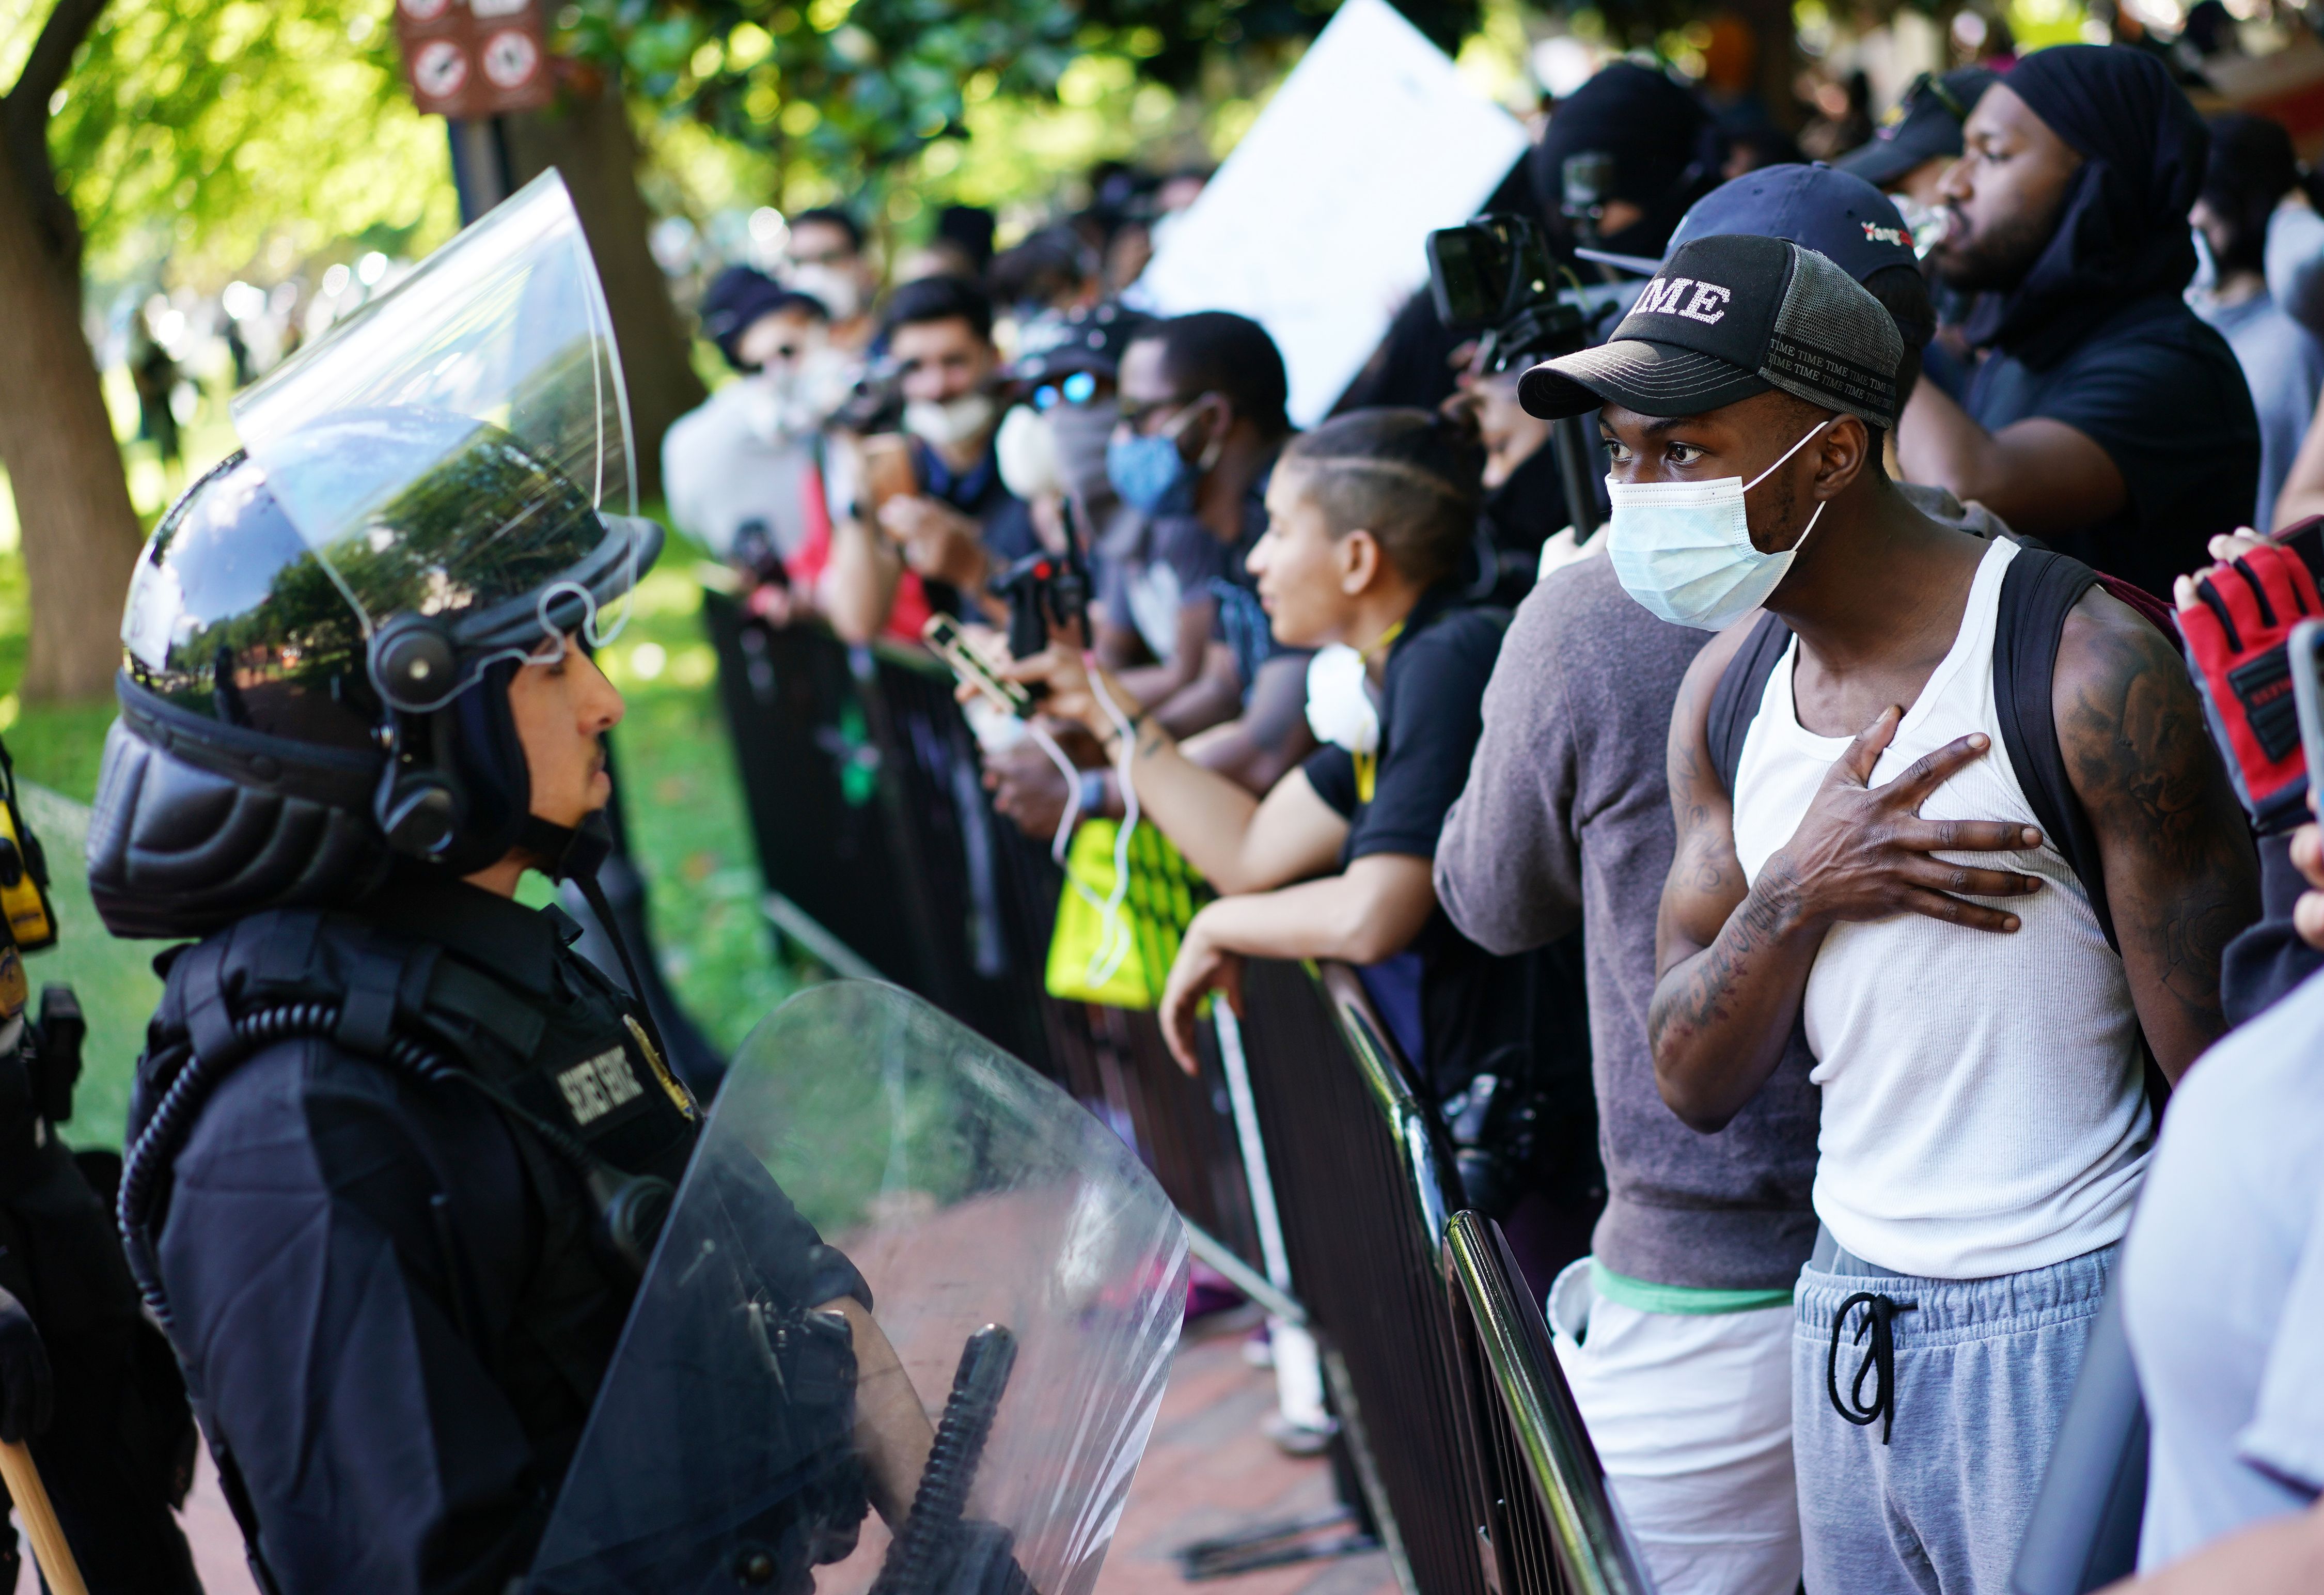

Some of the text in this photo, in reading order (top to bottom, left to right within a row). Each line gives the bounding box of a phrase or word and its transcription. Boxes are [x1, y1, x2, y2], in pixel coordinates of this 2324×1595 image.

[1768, 353, 1793, 371] TIME
[1794, 363, 1820, 381] TIME
[1822, 374, 1845, 391] TIME
[1845, 383, 1865, 399] TIME
[1865, 392, 1883, 406] TIME
[1770, 338, 1796, 356] TIME
[1798, 350, 1824, 368] TIME
[1826, 359, 1849, 378] TIME
[1850, 369, 1868, 385] TIME
[1870, 378, 1887, 393] TIME
